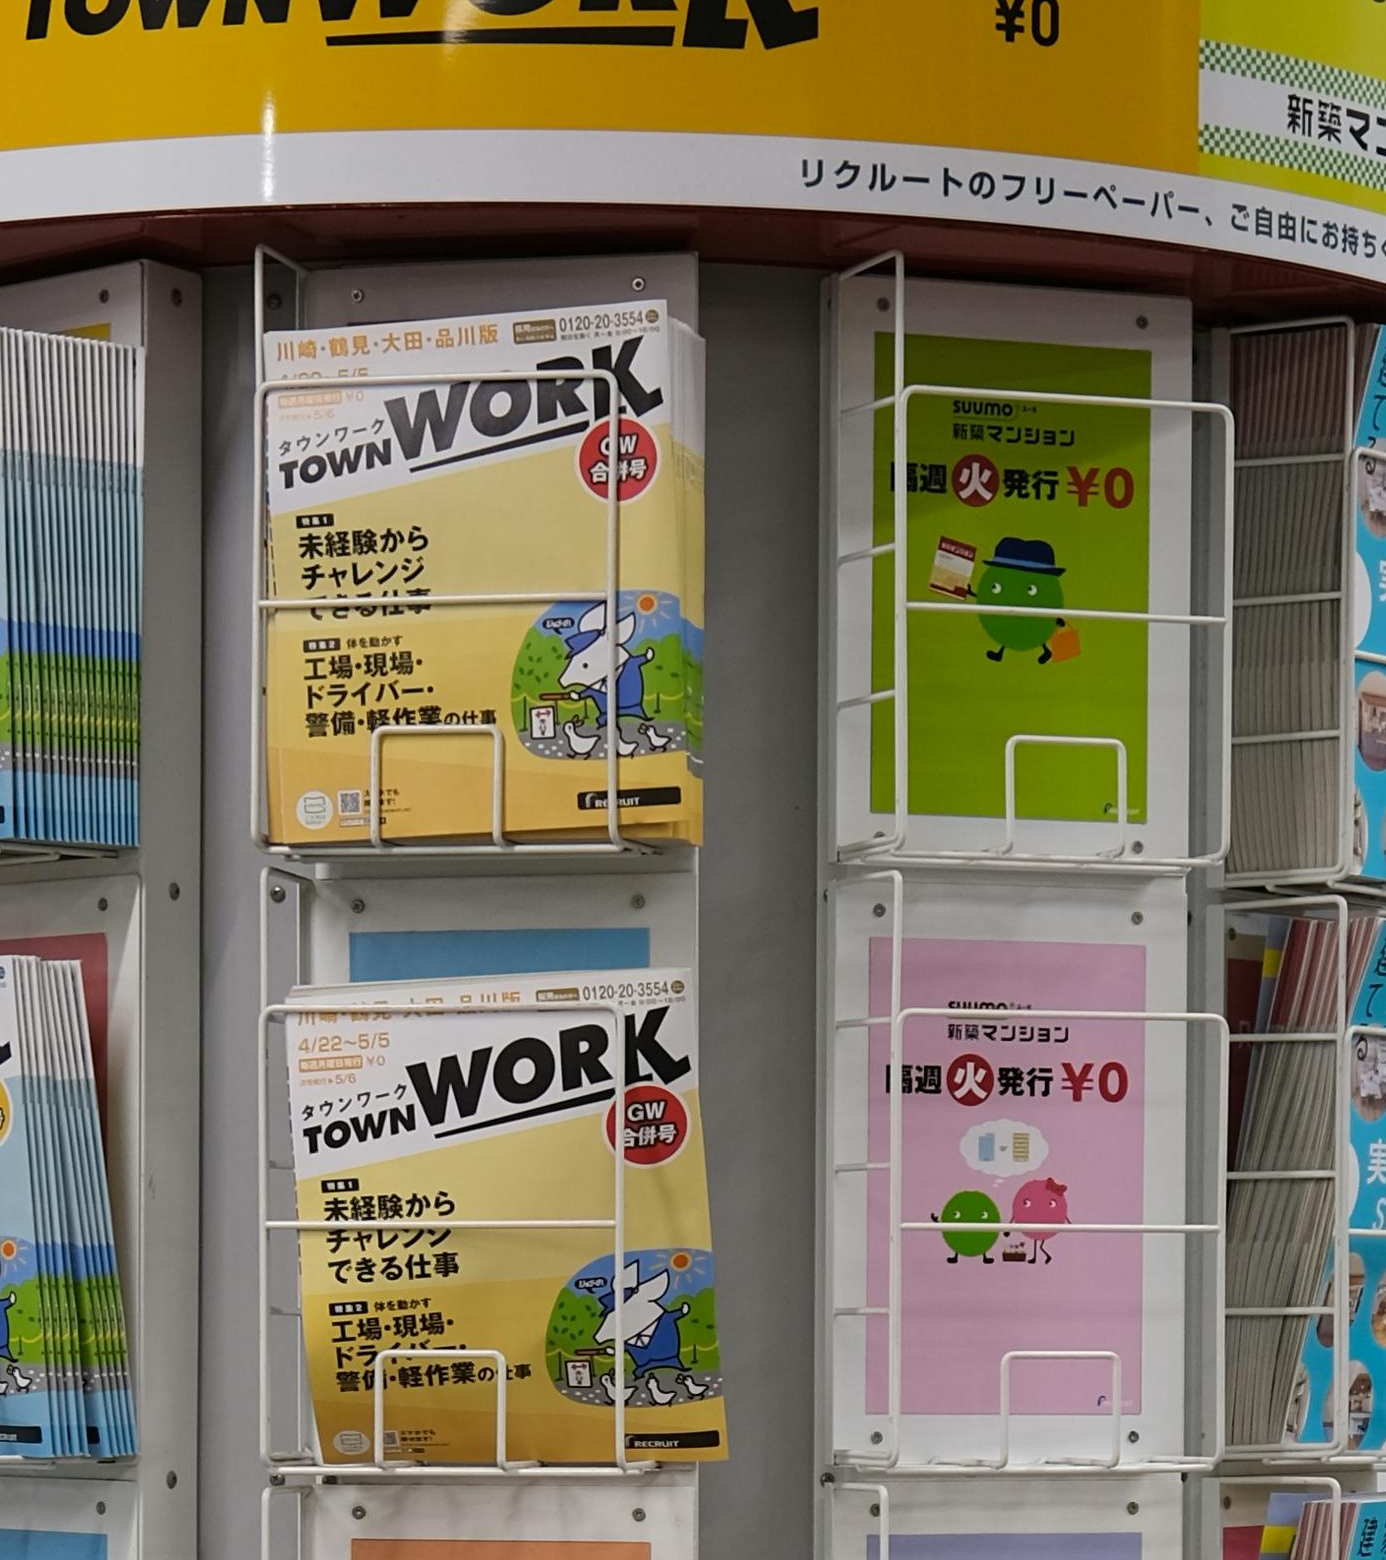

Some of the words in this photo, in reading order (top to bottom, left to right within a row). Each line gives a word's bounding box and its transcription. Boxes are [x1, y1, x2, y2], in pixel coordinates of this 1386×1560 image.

[559, 314, 643, 334] 0120-20-3554
[277, 324, 499, 361] 川崎・鶴見・大田・品川版
[279, 438, 392, 489] TOWN
[384, 335, 664, 459] WORK
[277, 417, 385, 457] タウンワーク
[952, 423, 1075, 447] 新築マンション
[1066, 466, 1135, 509] ¥0
[298, 526, 429, 558] 未経験から
[302, 556, 425, 590] チャレンジ
[304, 652, 423, 680] 工場・現場・
[305, 682, 434, 708] ドライバー・
[582, 982, 669, 1001] 0120-20-3554
[947, 1024, 1069, 1043] 新築マンション
[303, 1104, 416, 1155] TOWN
[405, 1005, 691, 1126] WORK
[335, 1073, 356, 1085] 5/6
[1061, 1062, 1129, 1103] ¥0
[302, 1084, 407, 1119] タウンワーク
[627, 1101, 666, 1120] GW
[324, 1192, 456, 1222] 未経験から
[327, 1252, 460, 1283] できる仕事
[331, 1312, 454, 1342] 工場・現場・
[633, 1439, 680, 1448] RECRUIT
